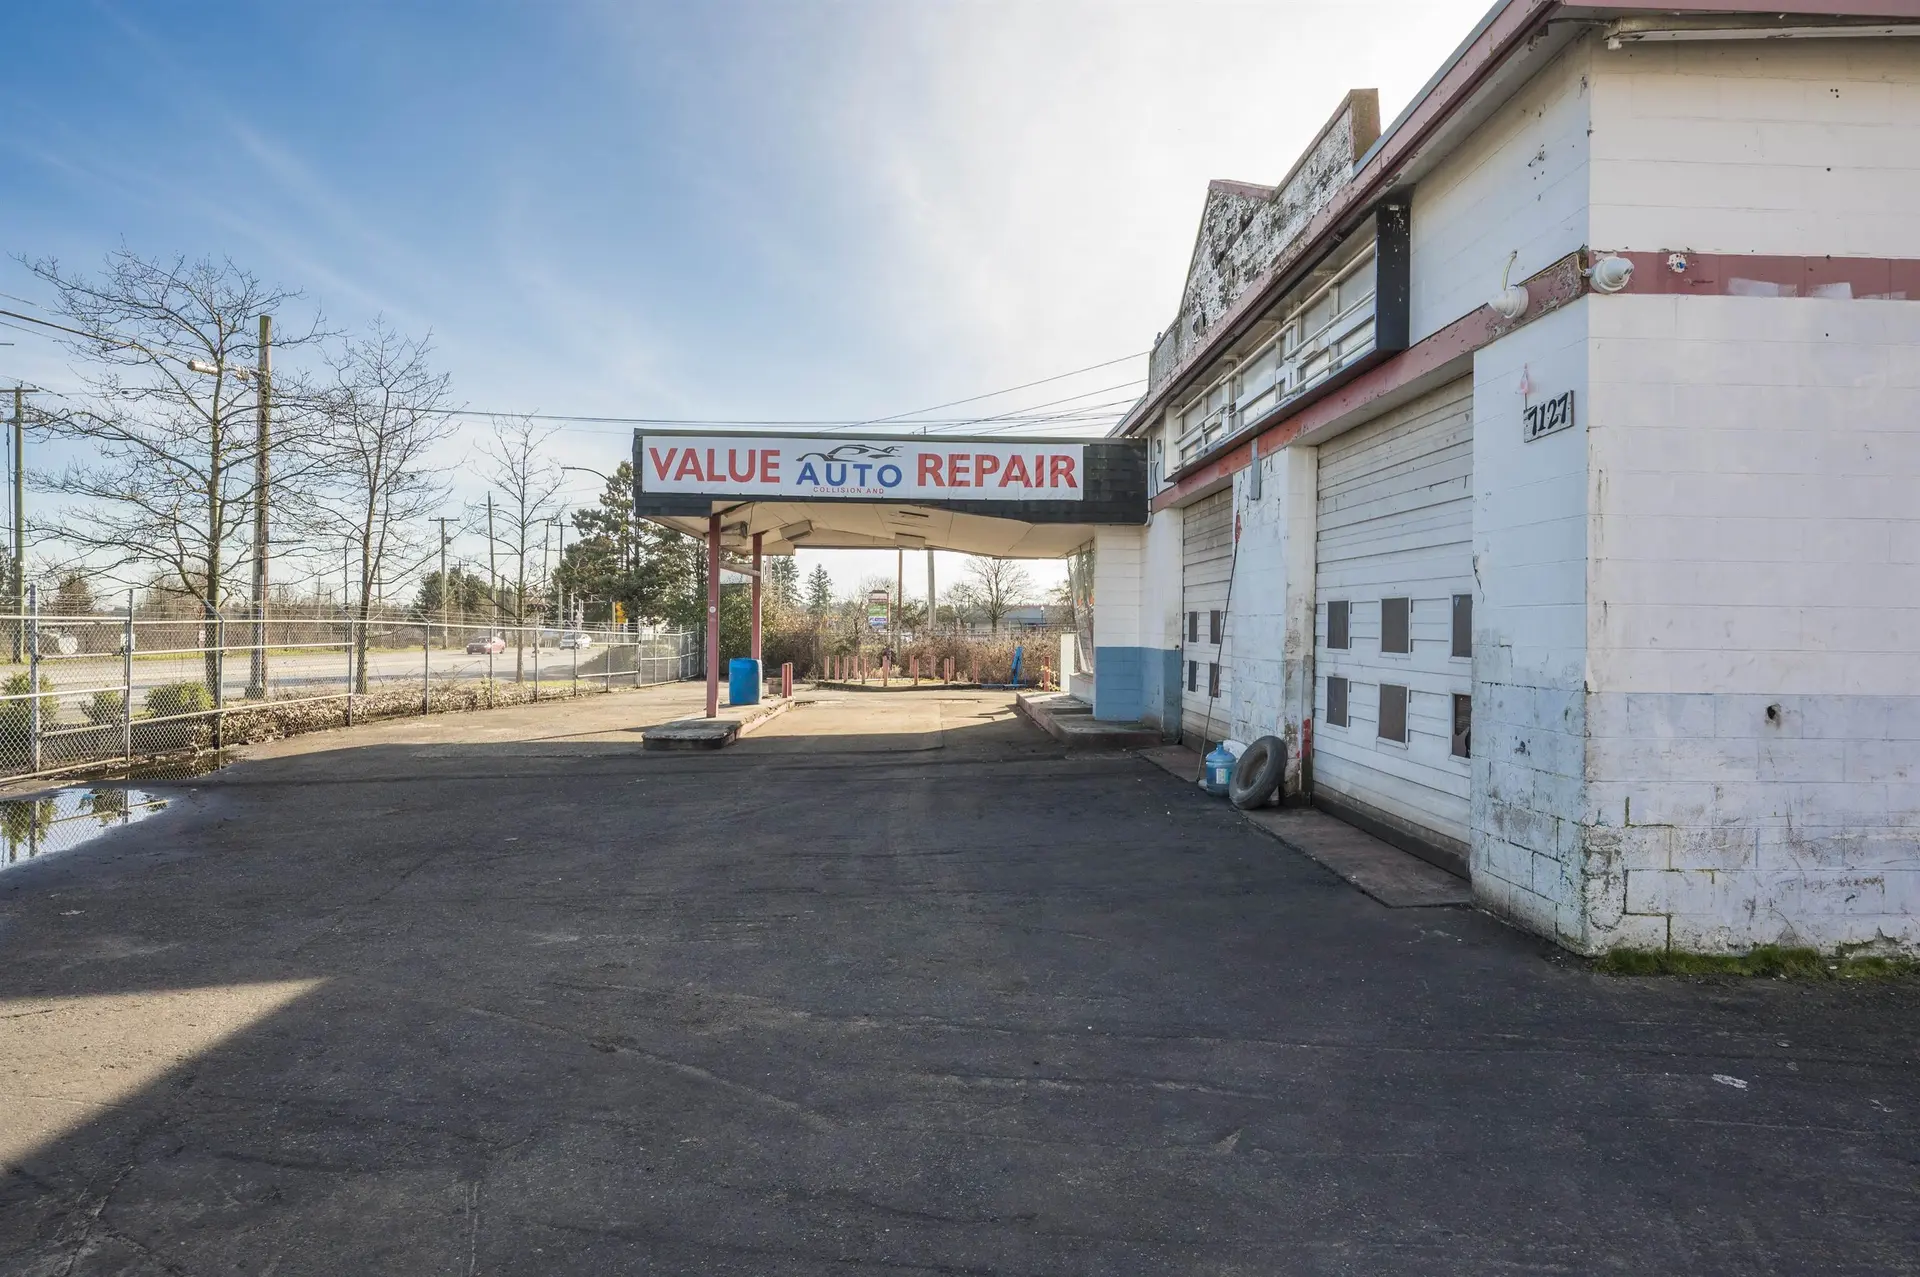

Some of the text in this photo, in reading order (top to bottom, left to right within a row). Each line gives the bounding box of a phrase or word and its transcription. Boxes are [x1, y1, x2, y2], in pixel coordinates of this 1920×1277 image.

[1527, 391, 1569, 436] 7127
[648, 447, 1078, 489] VALUE AUTO REPAIR
[813, 486, 885, 495] COLLISION AND
